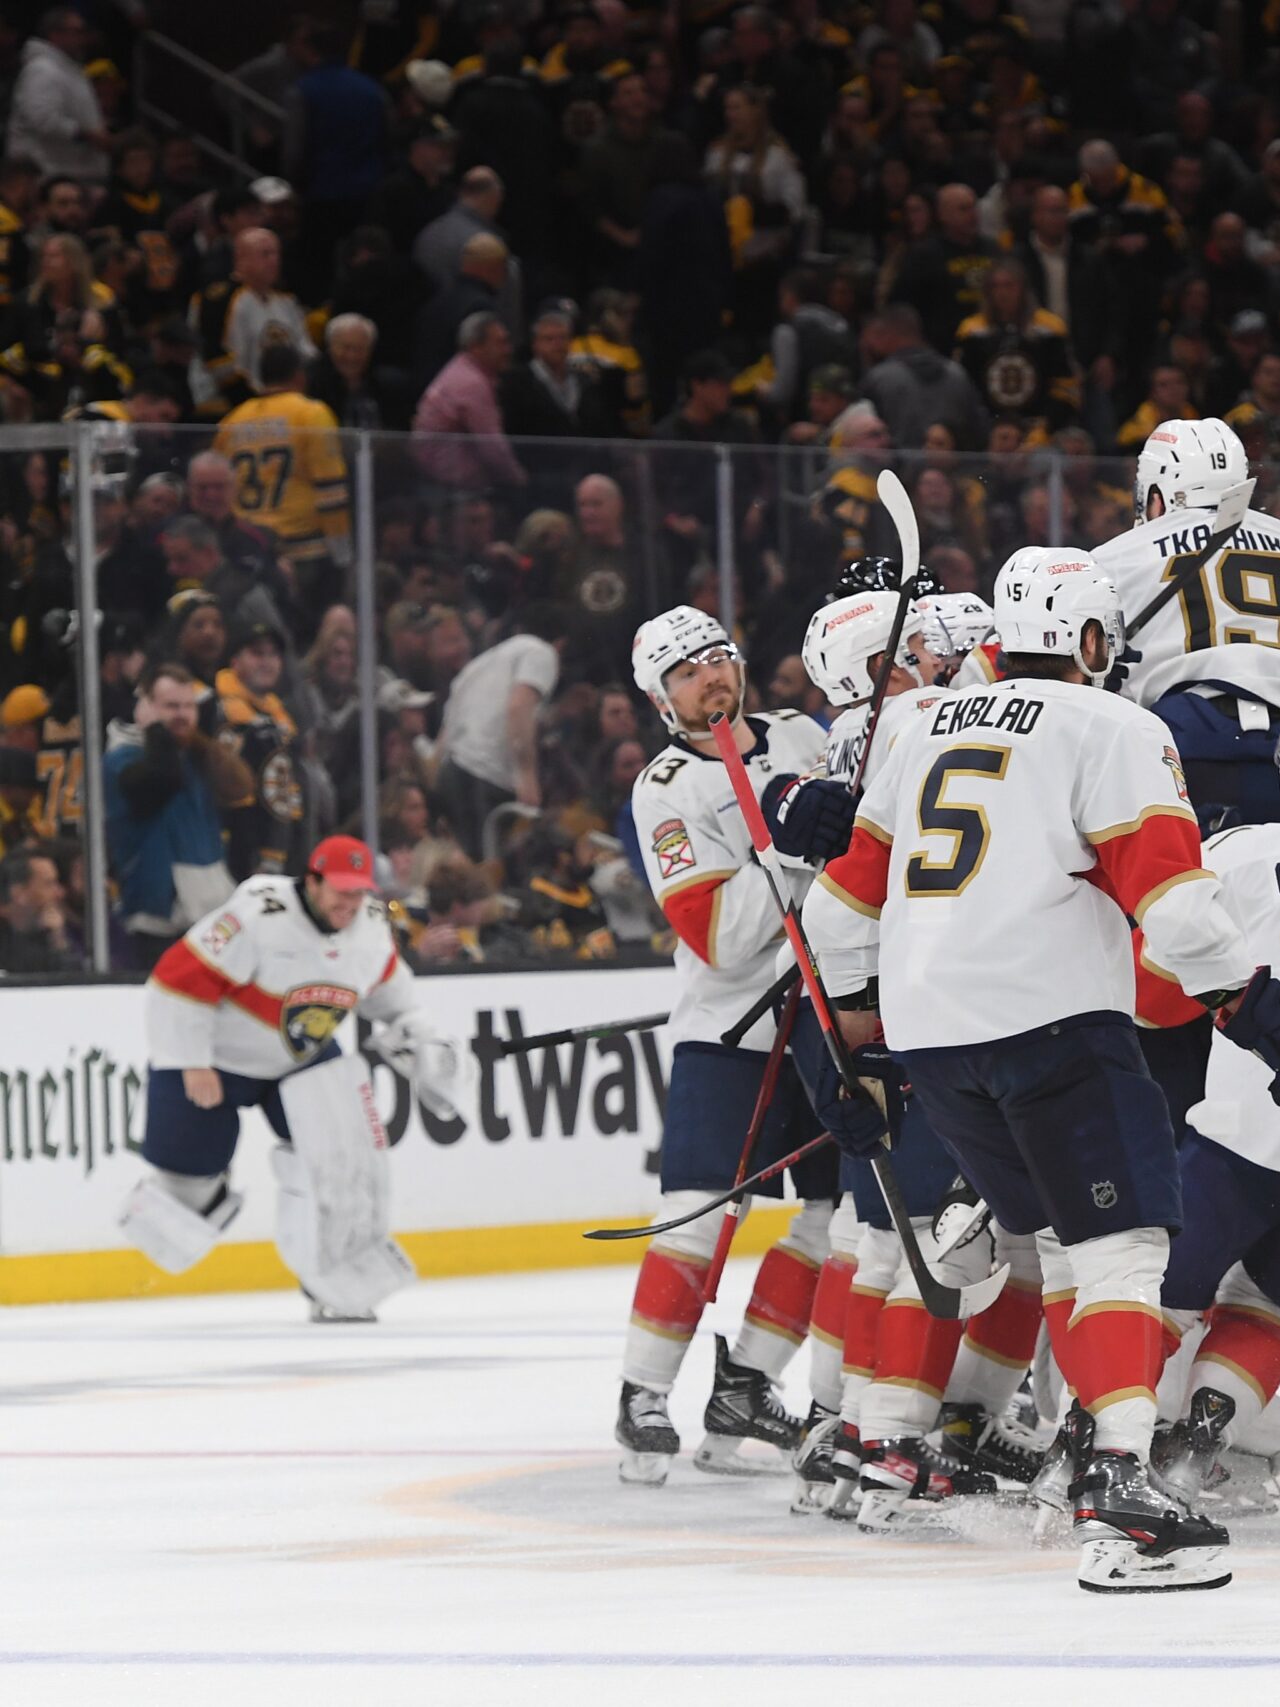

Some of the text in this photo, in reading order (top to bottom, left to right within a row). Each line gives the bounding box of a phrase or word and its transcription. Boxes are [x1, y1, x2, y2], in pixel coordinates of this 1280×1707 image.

[230, 445, 293, 510] 37
[1210, 452, 1226, 470] 19
[1013, 583, 1023, 602] 5
[930, 696, 1045, 737] EKBLAD
[904, 742, 1013, 898] 5
